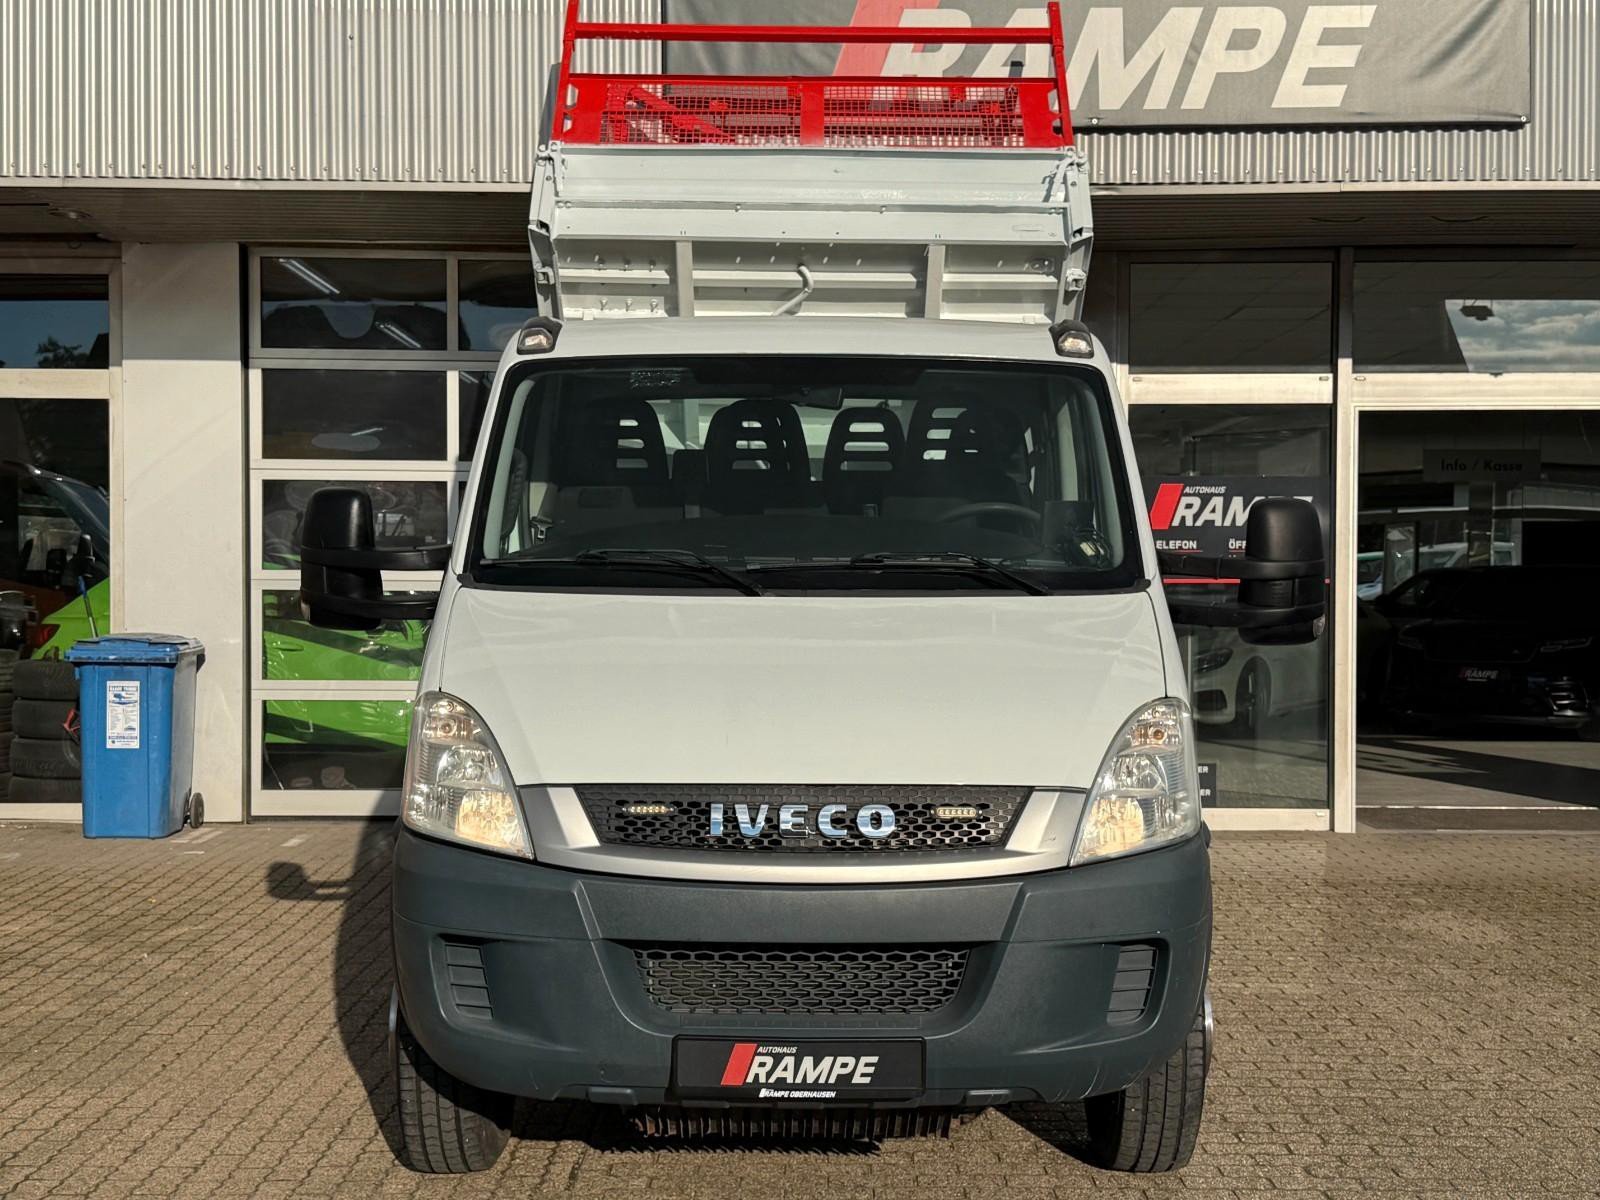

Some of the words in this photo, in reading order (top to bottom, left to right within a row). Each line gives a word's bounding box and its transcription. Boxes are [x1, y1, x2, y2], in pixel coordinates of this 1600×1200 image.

[1441, 458, 1467, 472] Info
[1483, 458, 1523, 472] Kasse
[1184, 486, 1227, 494] AUTOHAUS
[1171, 496, 1313, 527] RAM
[1156, 540, 1197, 549] ELEFON
[1229, 537, 1247, 549] ÖFF
[1197, 765, 1209, 773] ER
[1200, 788, 1211, 796] ER
[710, 803, 896, 838] IVECO
[756, 1046, 797, 1054] AUTOHAUS
[745, 1056, 880, 1084] RAMPE
[764, 1089, 790, 1098] RAMPE
[790, 1090, 837, 1098] OBERHAUSEN
